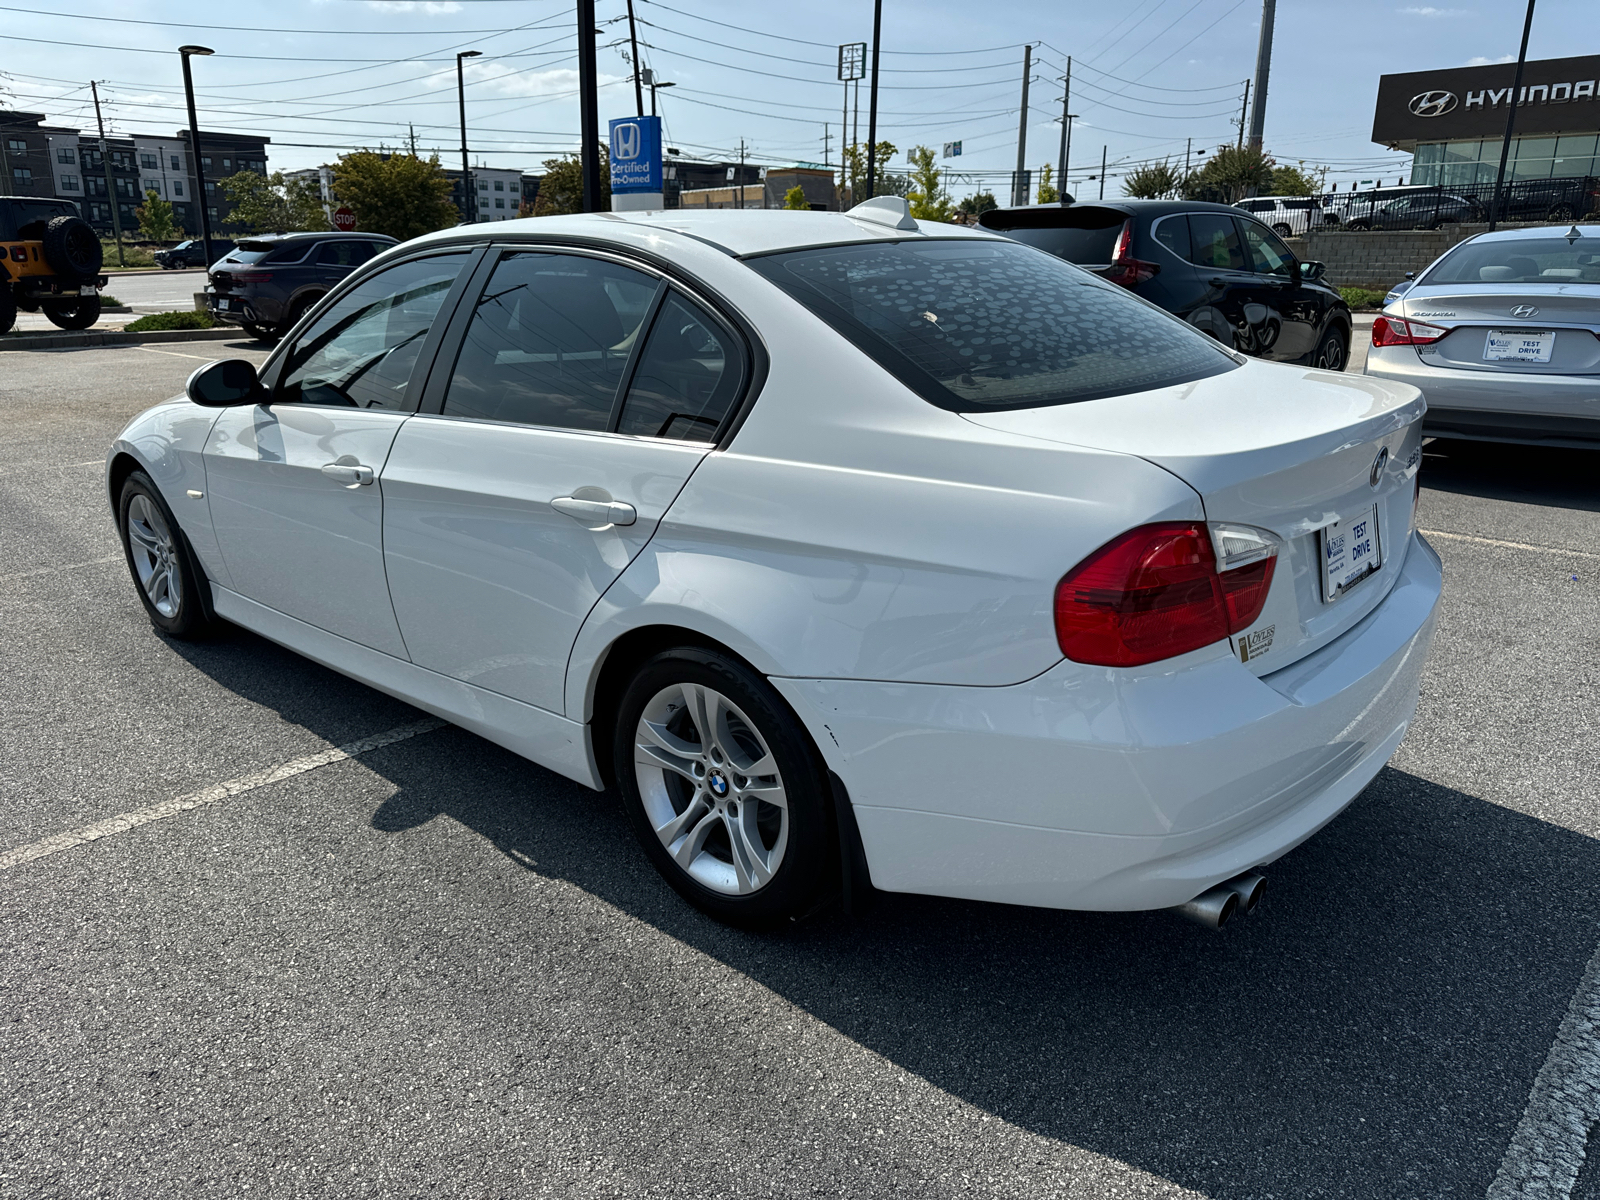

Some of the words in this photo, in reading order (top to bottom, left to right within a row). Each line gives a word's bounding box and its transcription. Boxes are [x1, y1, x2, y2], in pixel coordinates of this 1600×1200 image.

[611, 161, 650, 174] Certified
[611, 174, 650, 185] Pre-Owned
[335, 213, 355, 225] STOP
[1352, 521, 1367, 540] TEST
[1352, 539, 1371, 561] DRIVE
